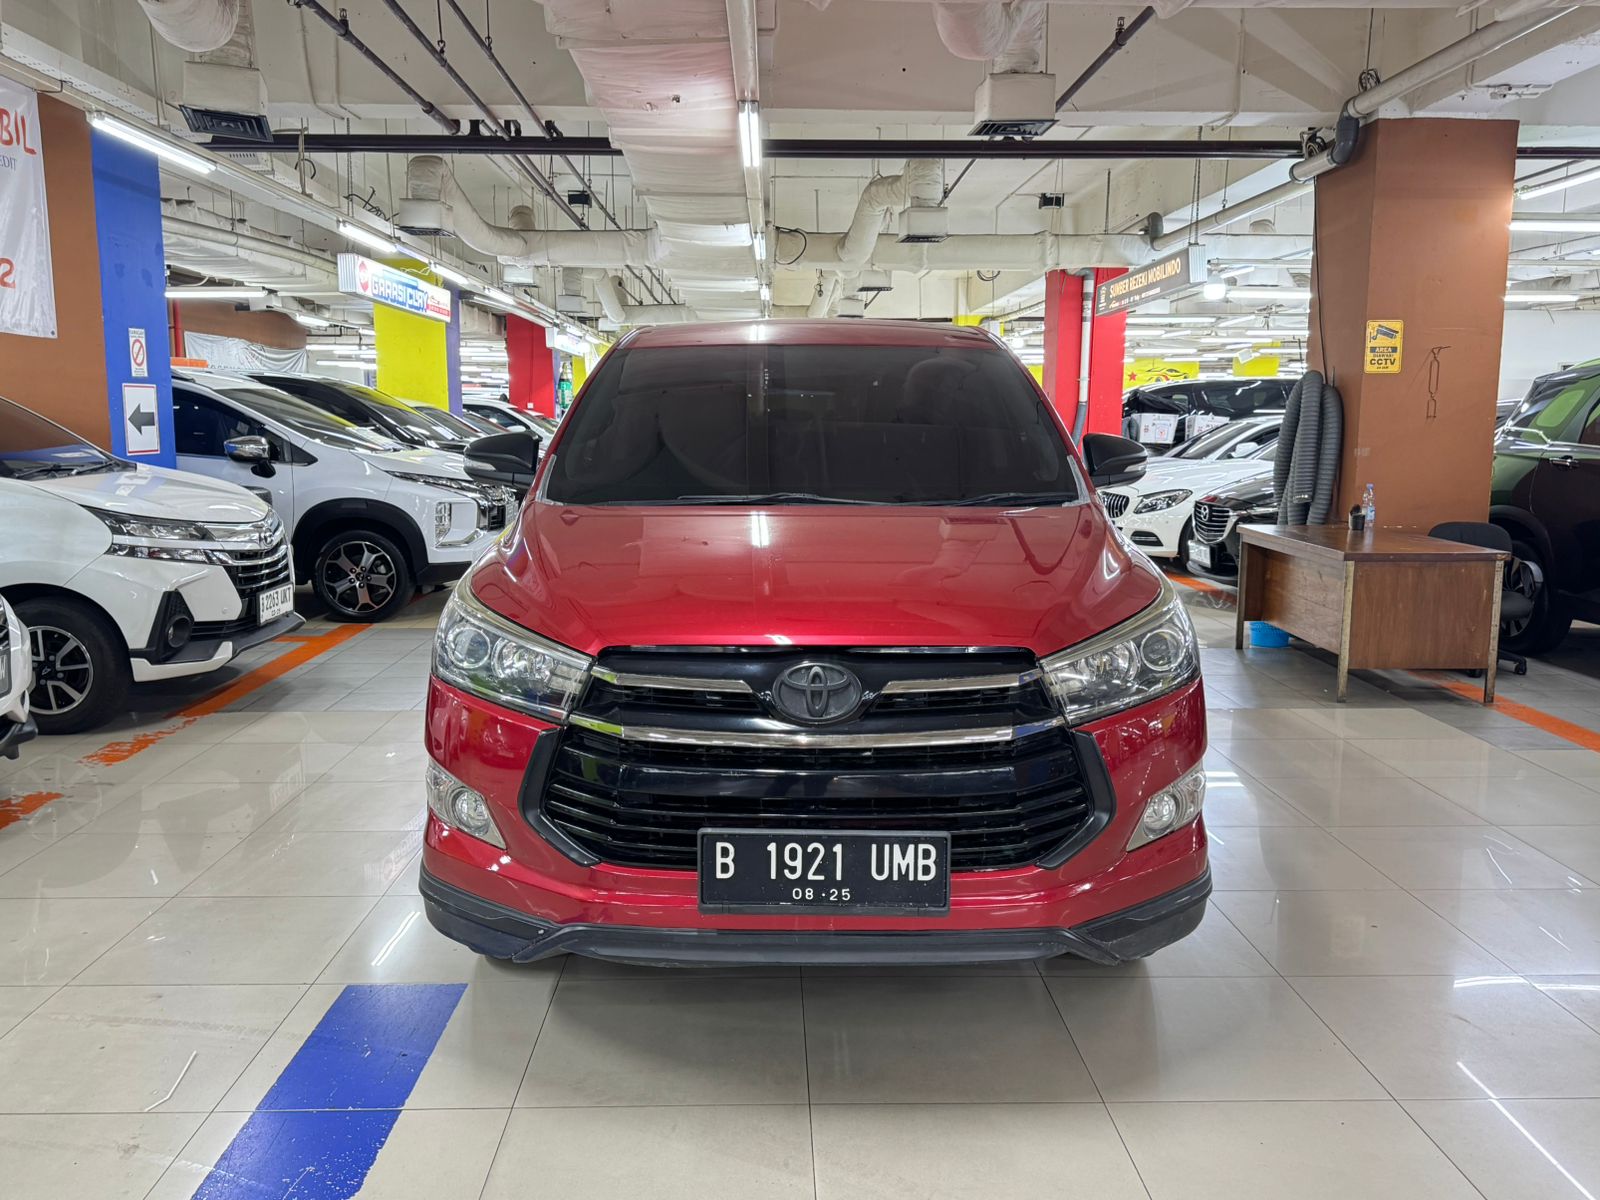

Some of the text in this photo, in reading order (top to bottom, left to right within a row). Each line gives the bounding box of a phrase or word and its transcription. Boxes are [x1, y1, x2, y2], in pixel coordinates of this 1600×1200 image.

[372, 276, 406, 306] GARASI
[1110, 278, 1129, 298] SUMBER
[1130, 271, 1148, 291] REZEKI
[1148, 257, 1181, 284] MOBILINDO
[1370, 358, 1396, 366] CCTV
[715, 841, 937, 881] B 1921 UMB
